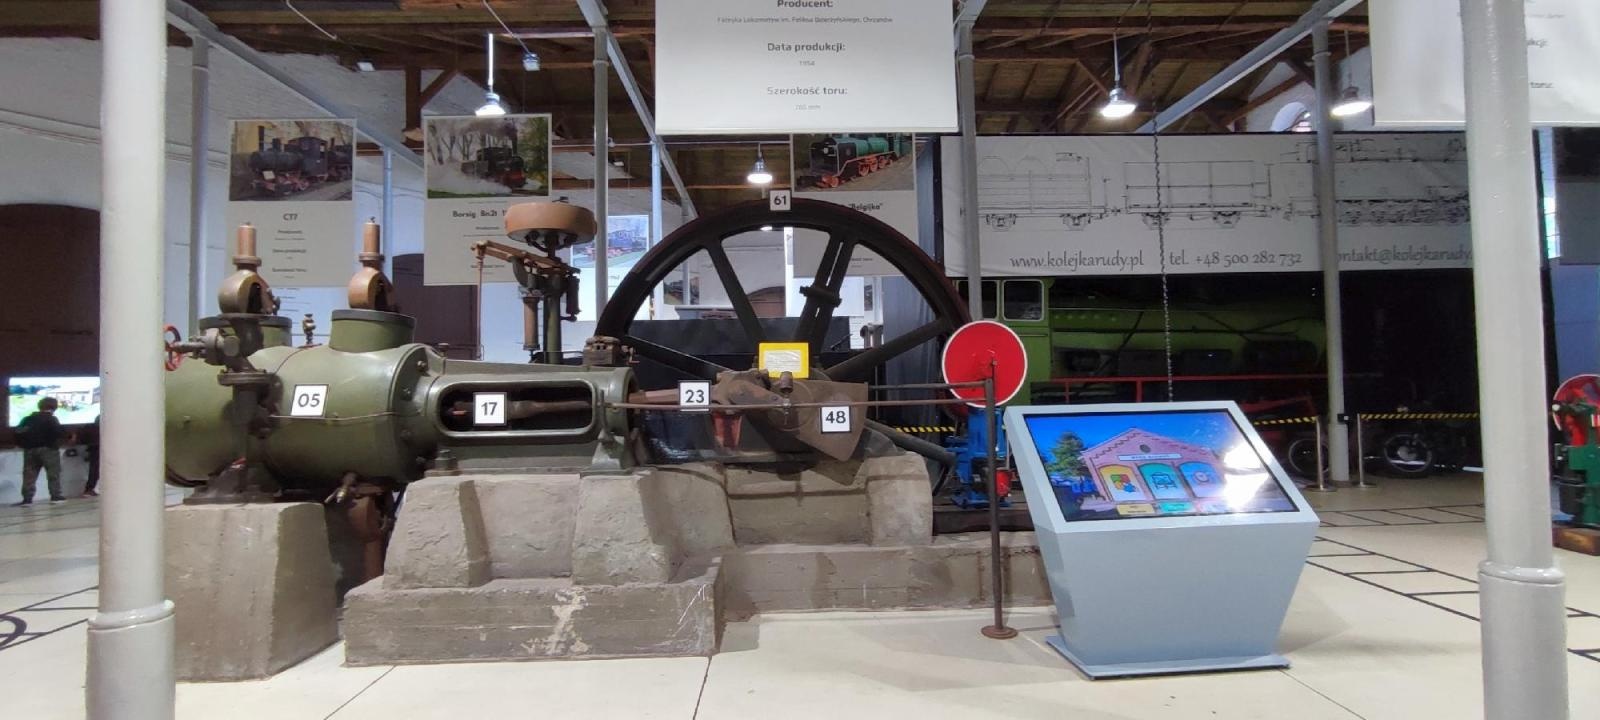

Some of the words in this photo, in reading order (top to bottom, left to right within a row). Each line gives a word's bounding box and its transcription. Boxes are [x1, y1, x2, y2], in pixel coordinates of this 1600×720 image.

[777, 0, 834, 8] Producent:
[767, 42, 792, 52] Data
[794, 42, 846, 53] produkcji:
[767, 85, 820, 95] Szerokość
[823, 86, 848, 95] toru:
[773, 195, 787, 205] 61
[1009, 249, 1145, 272] www.kolejkarudy.pl
[1169, 249, 1190, 266] tel.
[1196, 251, 1220, 268] +48
[1223, 254, 1249, 268] 500
[1252, 250, 1276, 264] 282
[1279, 253, 1302, 267] 732
[296, 393, 321, 408] 05
[685, 389, 705, 404] 23
[480, 401, 498, 416] 17
[825, 410, 847, 424] 48
